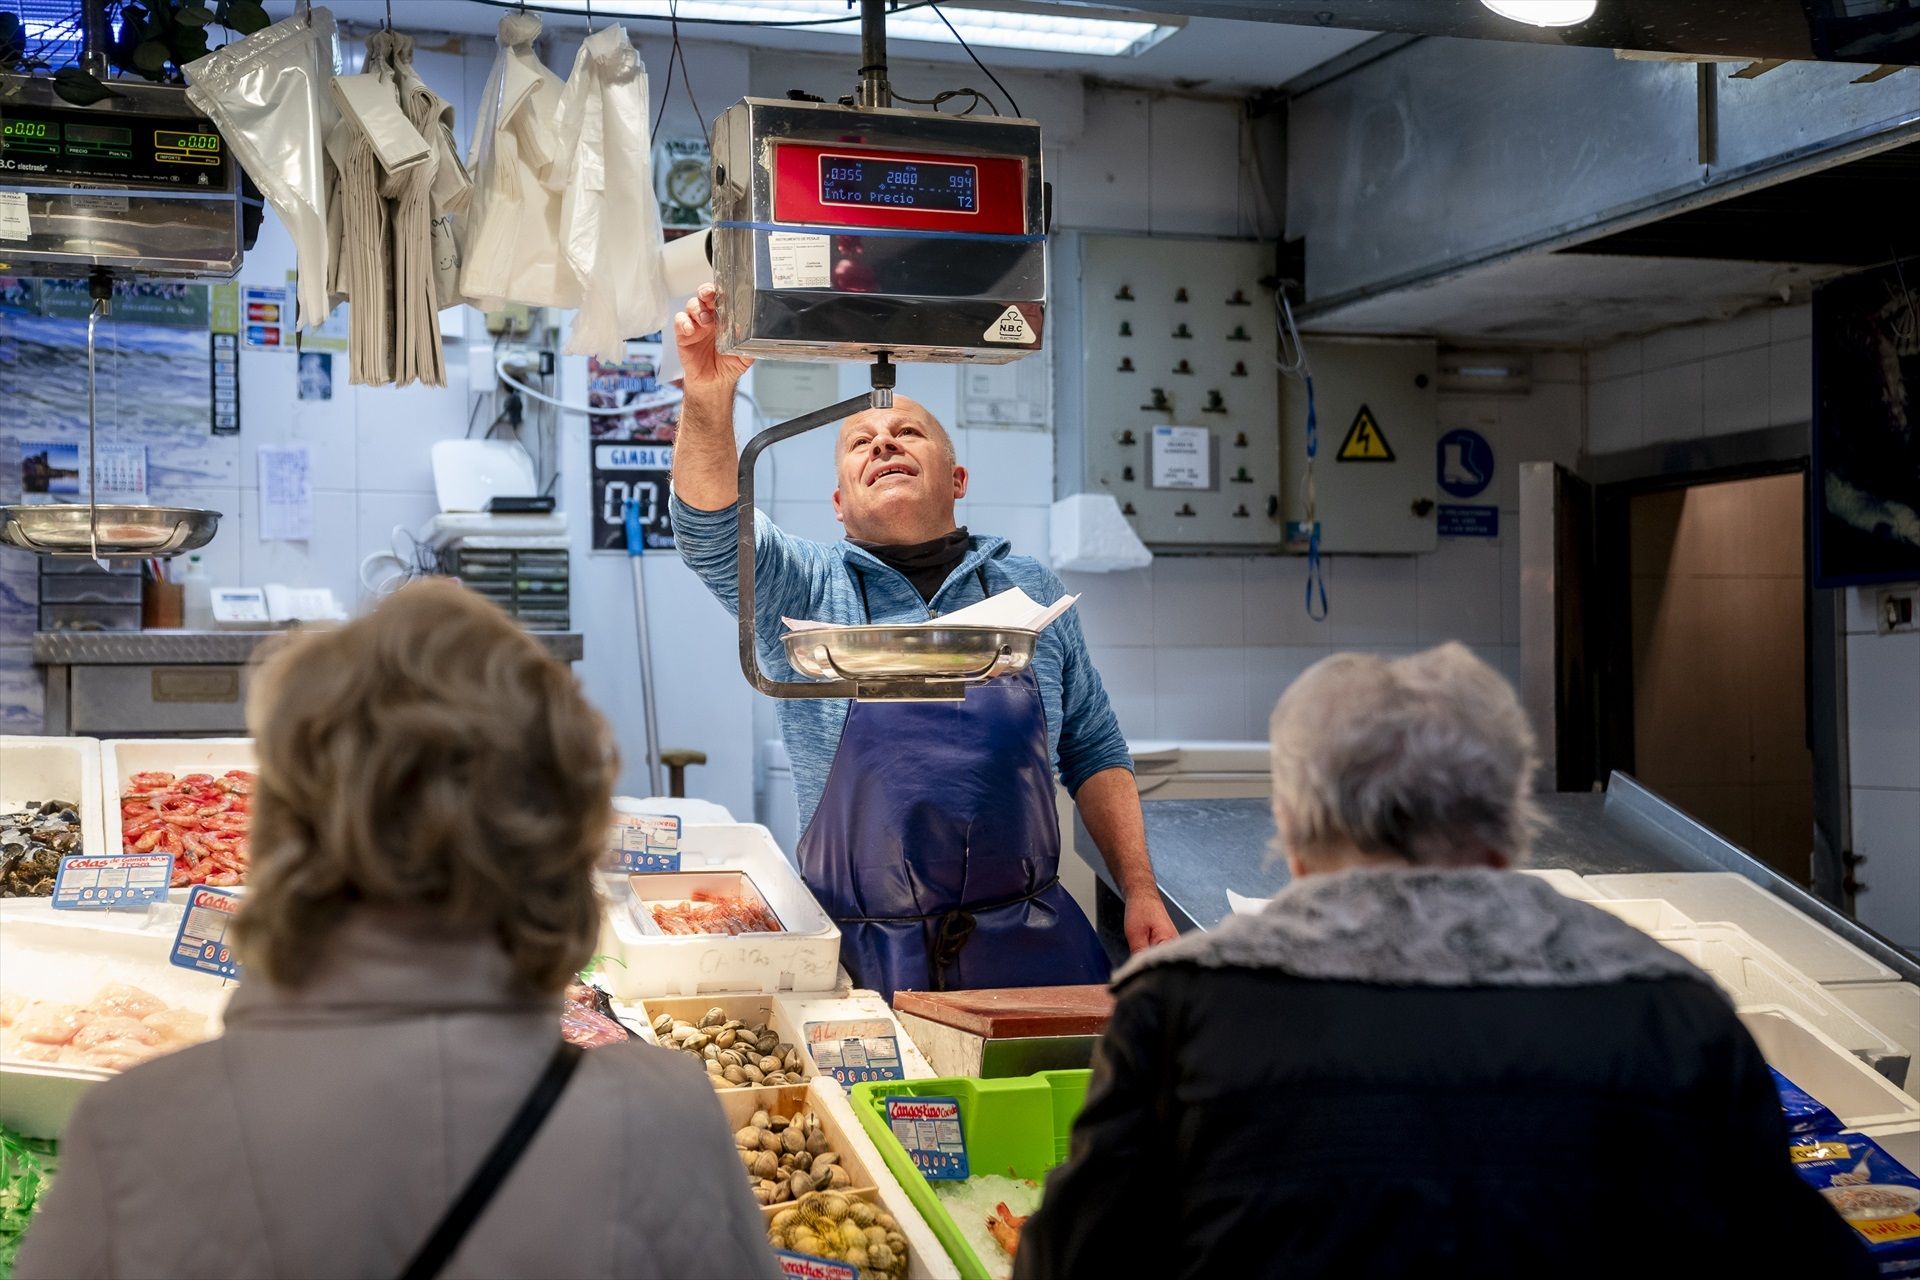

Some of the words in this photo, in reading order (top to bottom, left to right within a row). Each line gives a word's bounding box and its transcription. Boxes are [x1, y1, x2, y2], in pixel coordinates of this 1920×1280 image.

[825, 188, 862, 200] Intro
[870, 192, 914, 204] Precio
[957, 196, 972, 207] T2
[611, 451, 655, 466] GAMBA
[67, 859, 108, 870] Colas
